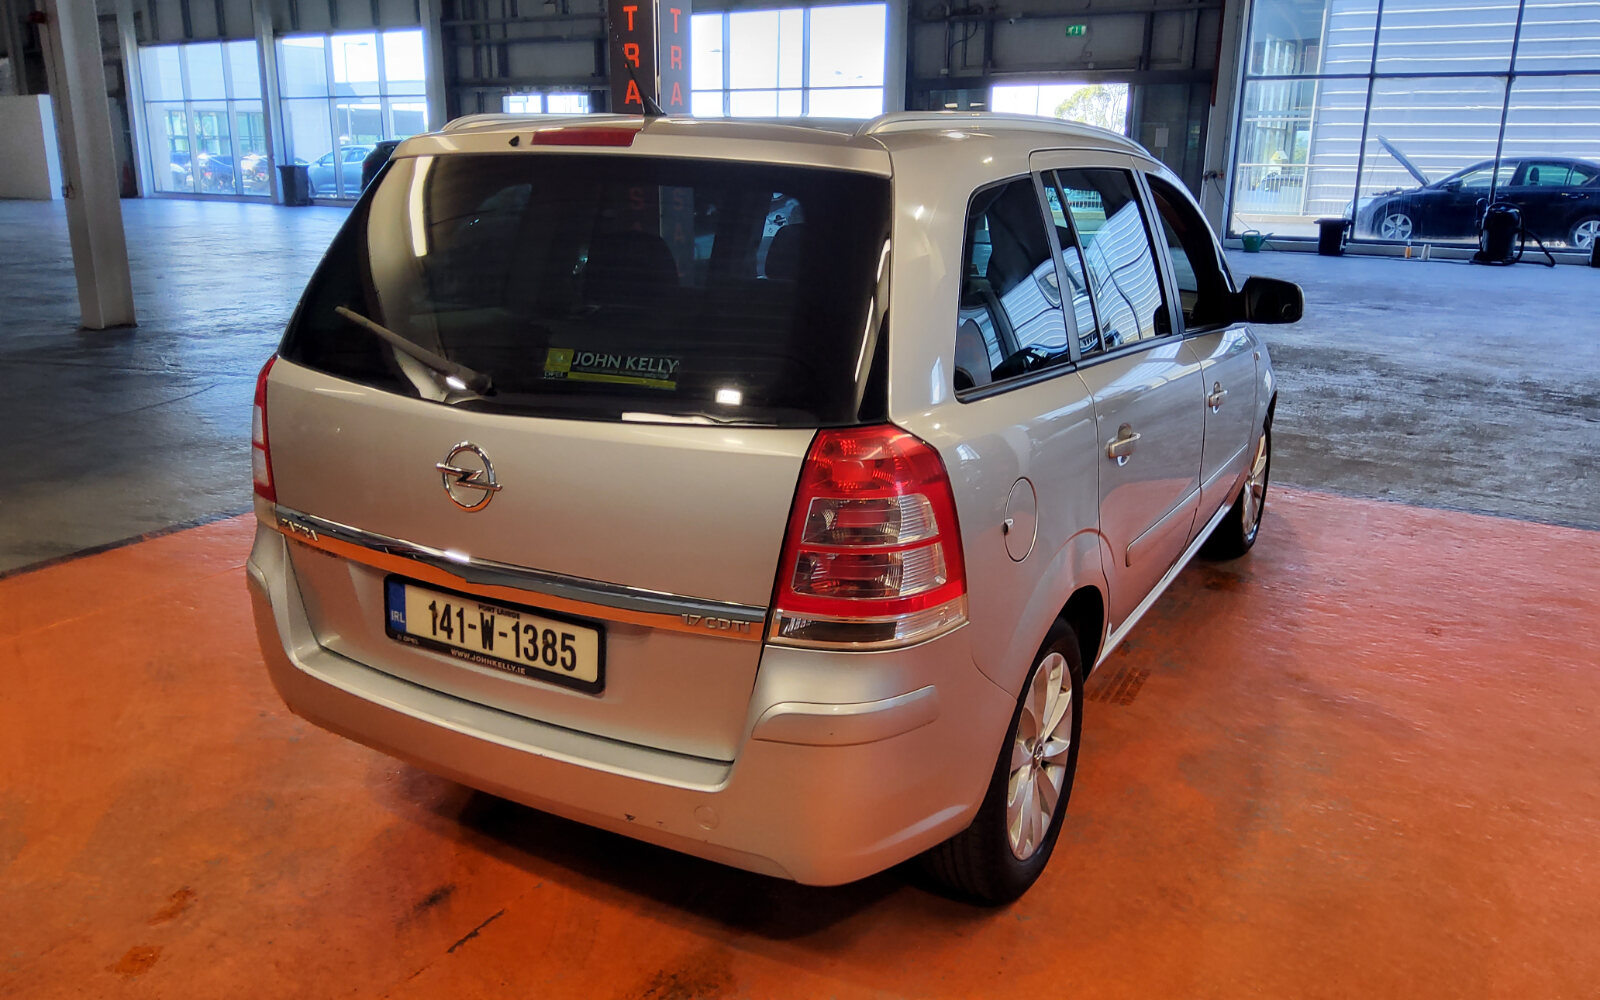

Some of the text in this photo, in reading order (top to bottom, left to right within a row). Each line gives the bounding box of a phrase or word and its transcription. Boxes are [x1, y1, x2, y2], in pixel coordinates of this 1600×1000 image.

[573, 352, 622, 368] JOHN
[626, 356, 679, 374] KELLY
[391, 610, 405, 623] IRL
[428, 600, 577, 672] 141-W-1385
[451, 648, 526, 675] WWW.JOHNKELLY.IE
